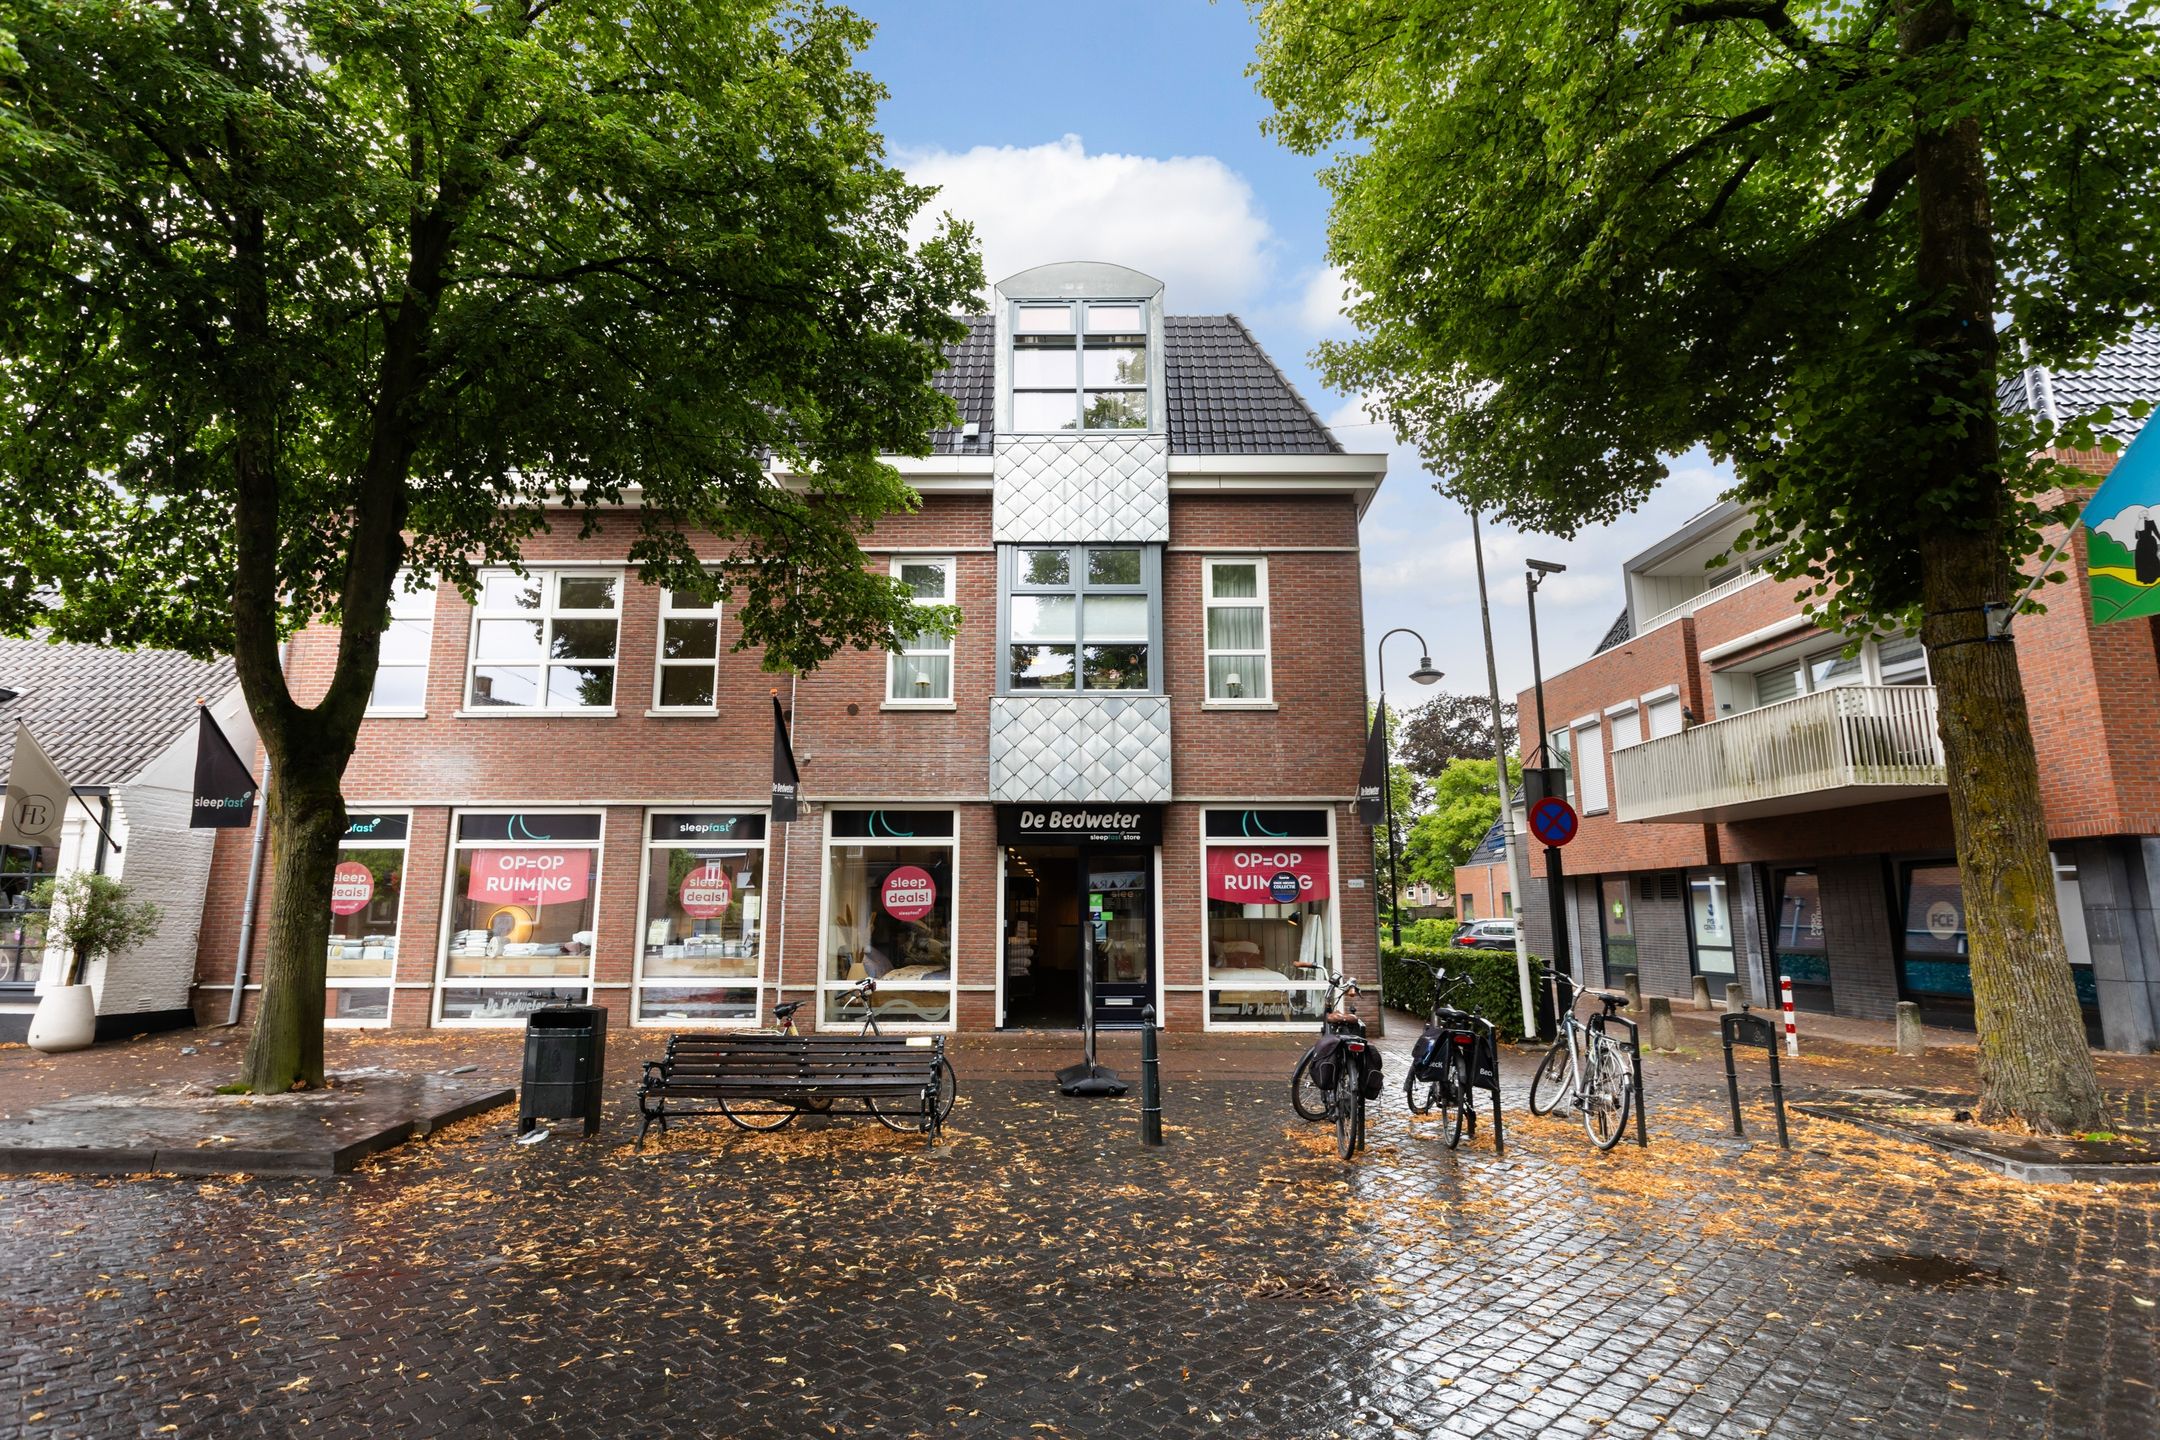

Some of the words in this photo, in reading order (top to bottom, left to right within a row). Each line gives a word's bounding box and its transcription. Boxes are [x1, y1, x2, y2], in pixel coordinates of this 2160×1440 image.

[194, 796, 244, 810] sleepfast
[1020, 811, 1046, 828] De
[1049, 810, 1141, 829] Bedweter
[679, 822, 730, 833] sleepfast
[499, 855, 565, 870] OP=OP
[1234, 852, 1302, 868] OP=OP
[486, 876, 572, 892] RUIMING
[689, 876, 724, 888] sleep
[890, 877, 927, 888] sleep
[1224, 874, 1313, 890] RUIMG
[686, 891, 725, 902] deals!
[889, 892, 929, 903] deals!
[1931, 913, 1954, 927] FCE
[487, 998, 499, 1010] De
[501, 998, 547, 1010] Bedweter
[1241, 1002, 1253, 1015] De
[1256, 1002, 1300, 1015] Bedweter
